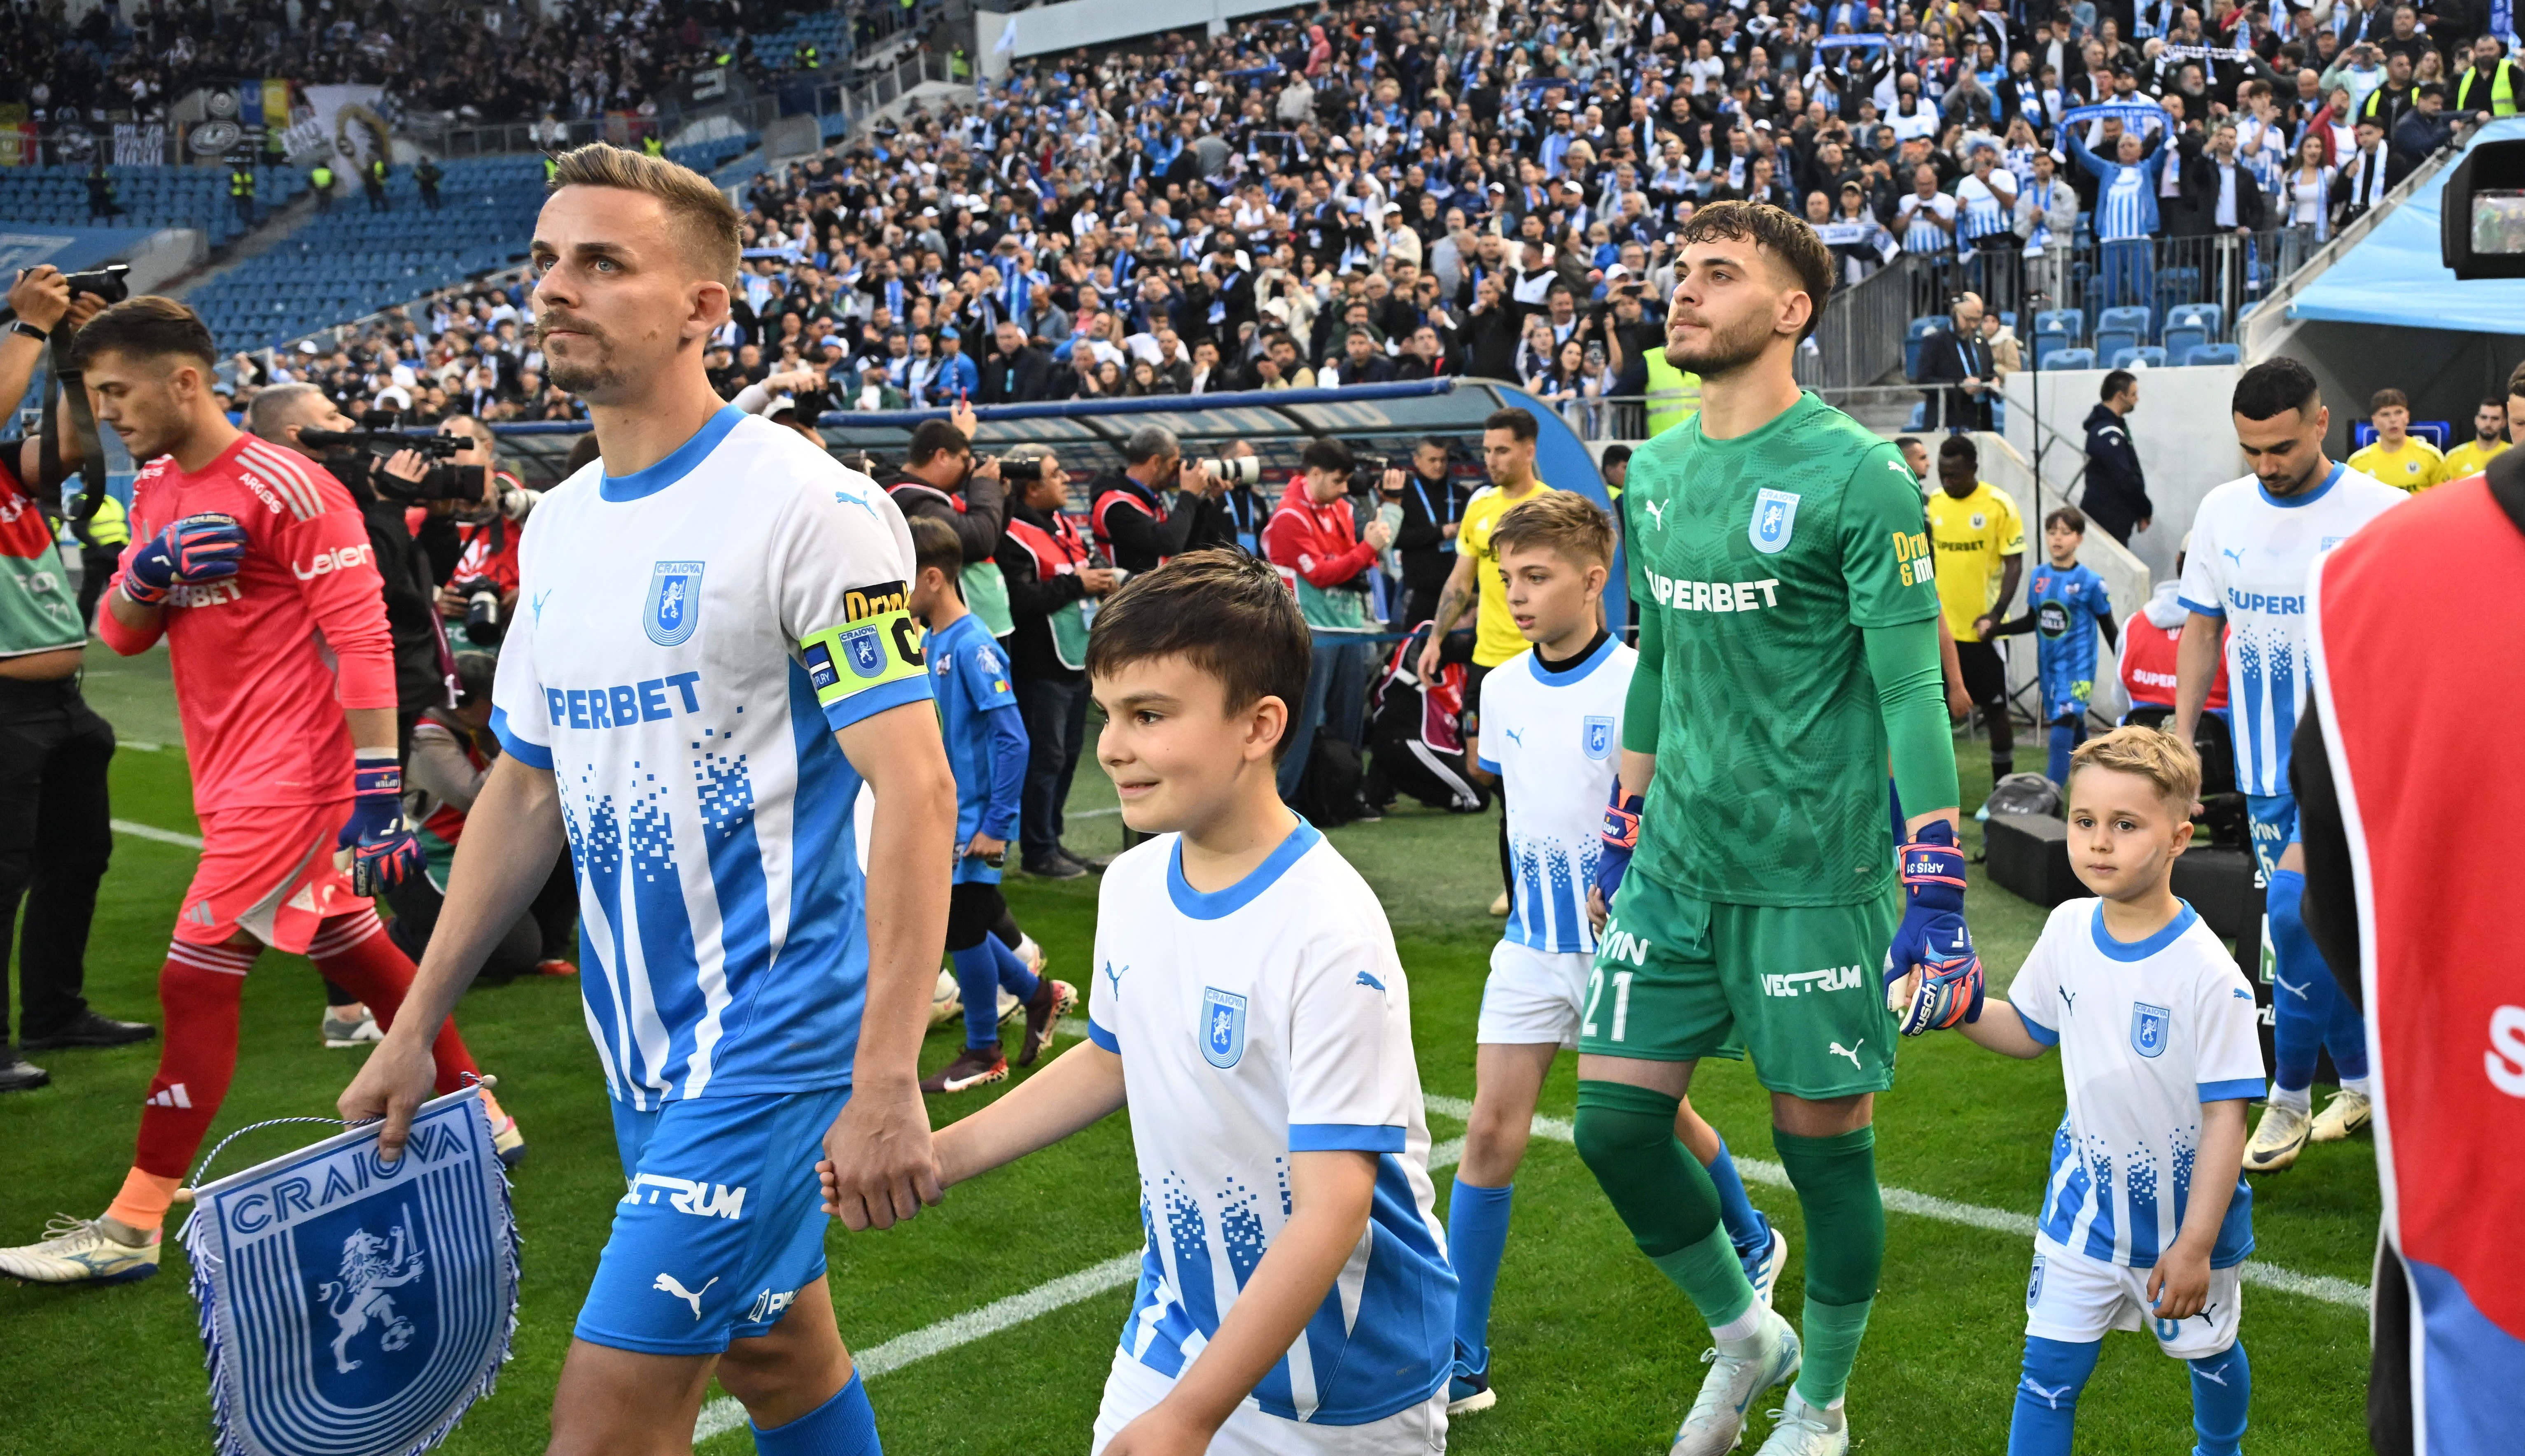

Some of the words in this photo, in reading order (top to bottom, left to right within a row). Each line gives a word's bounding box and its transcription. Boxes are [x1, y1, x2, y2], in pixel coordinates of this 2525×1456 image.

[1760, 490, 1799, 503] CRAIOVA
[1893, 532, 1929, 562] Drin
[1937, 540, 1984, 551] UPERBET
[292, 543, 373, 580] Leier
[657, 562, 701, 574] CRAIOVA
[1900, 564, 1913, 586] &
[1913, 556, 1934, 583] mo
[1644, 565, 1779, 612] UPERBET
[2228, 587, 2304, 614] SUPER
[841, 627, 876, 641] CRAIOVA
[891, 617, 924, 666] C
[816, 673, 829, 687] PLAY
[2133, 669, 2177, 688] SUPER
[539, 671, 700, 729] PERBET
[1907, 863, 1915, 874] 31
[1917, 862, 1944, 874] ARIS
[1762, 965, 1861, 997] VECTRUM
[1206, 990, 1244, 1008] CRAIOVA
[1582, 967, 1633, 1041] 21
[2136, 1004, 2168, 1018] CRAIOVA
[232, 1123, 467, 1233] CRAIOVA
[621, 1172, 746, 1220] CTRUM
